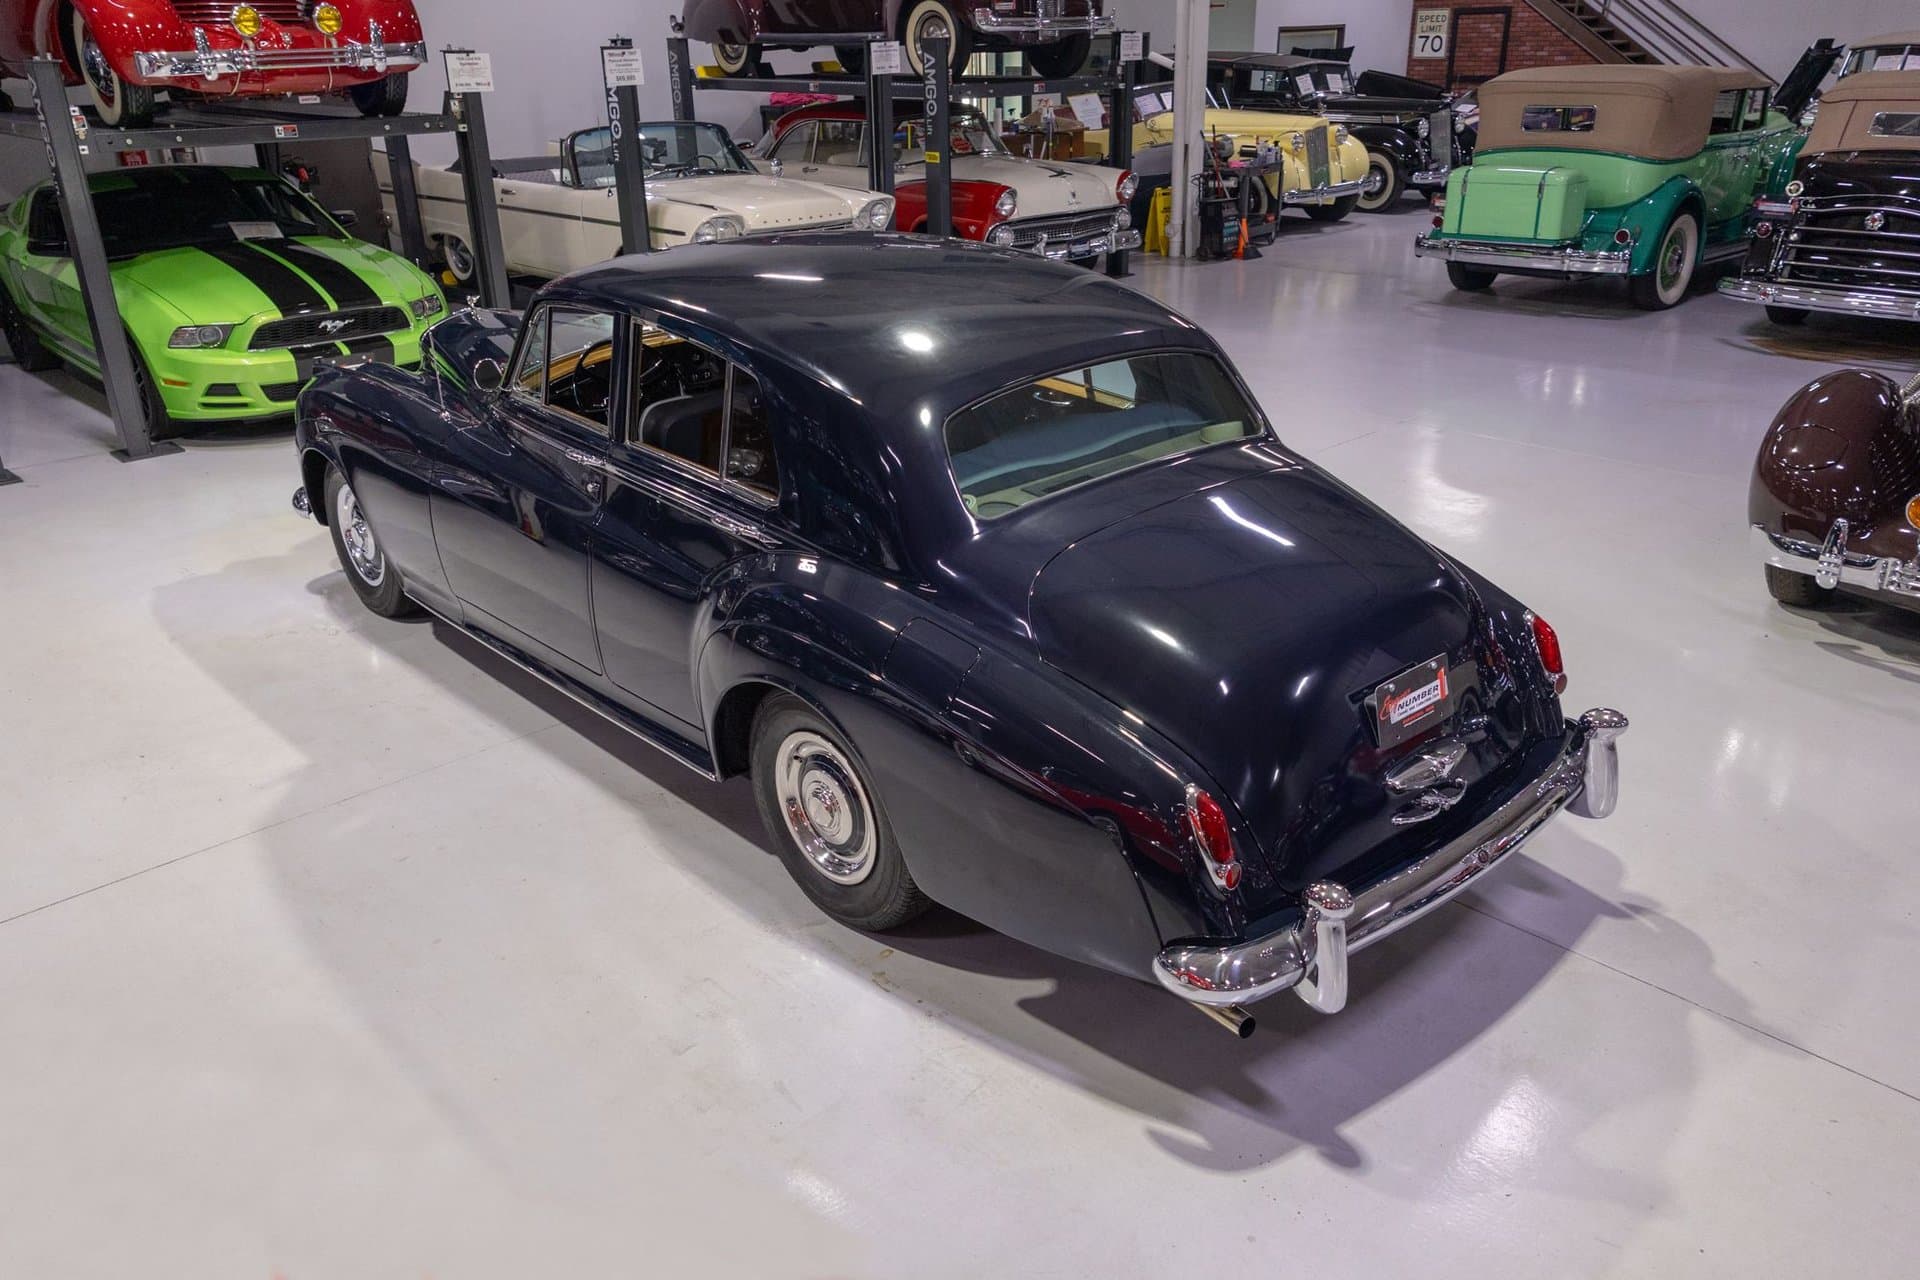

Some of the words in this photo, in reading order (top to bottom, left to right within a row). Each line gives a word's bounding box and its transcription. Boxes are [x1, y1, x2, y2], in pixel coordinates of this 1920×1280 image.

[1419, 15, 1447, 23] SPEED
[1420, 25, 1443, 33] LIMIT
[1418, 35, 1443, 53] 70
[669, 50, 681, 104] AMGO
[923, 52, 937, 116] AMGO
[27, 72, 56, 168] AMGO
[607, 87, 622, 140] MGO
[1397, 684, 1439, 711] NUMBER
